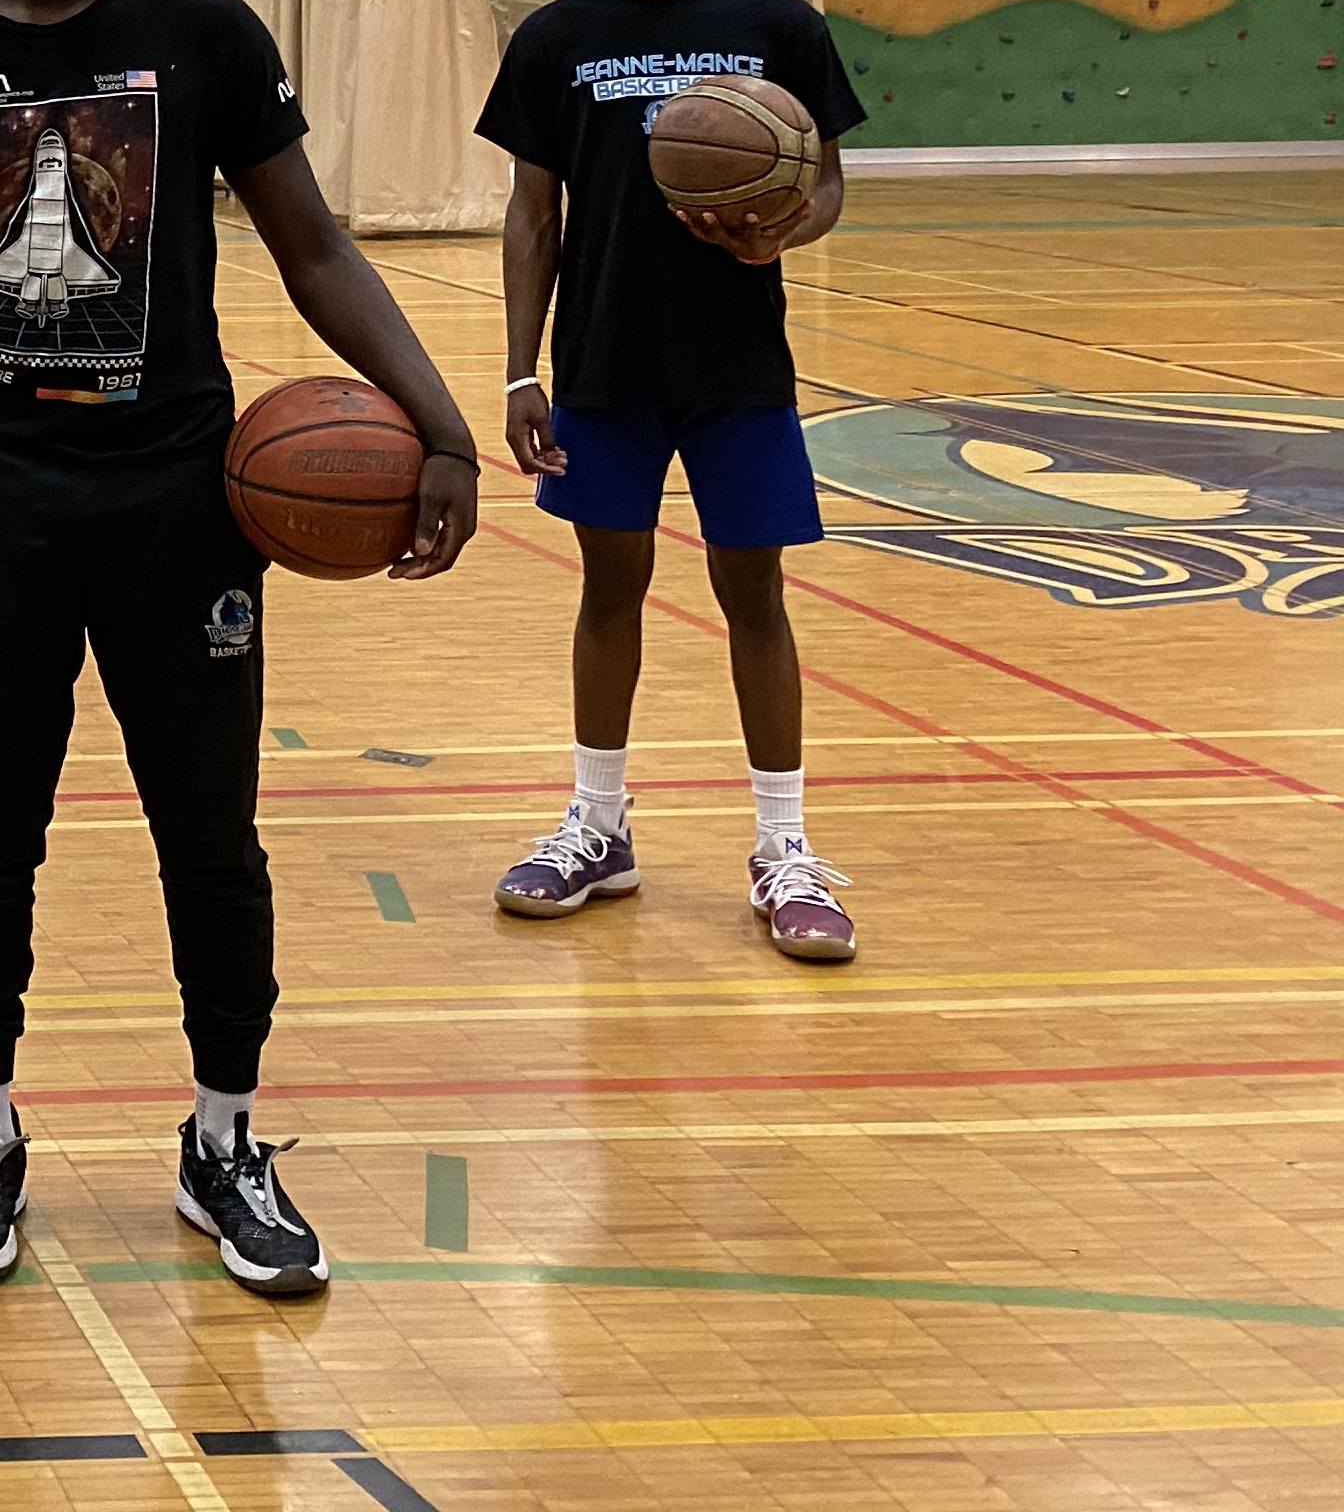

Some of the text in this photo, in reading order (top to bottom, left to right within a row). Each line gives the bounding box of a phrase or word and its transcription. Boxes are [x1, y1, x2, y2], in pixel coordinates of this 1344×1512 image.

[94, 72, 125, 83] United
[571, 53, 764, 87] JEANNE-MANCE
[97, 82, 125, 92] States
[97, 372, 142, 391] 1981
